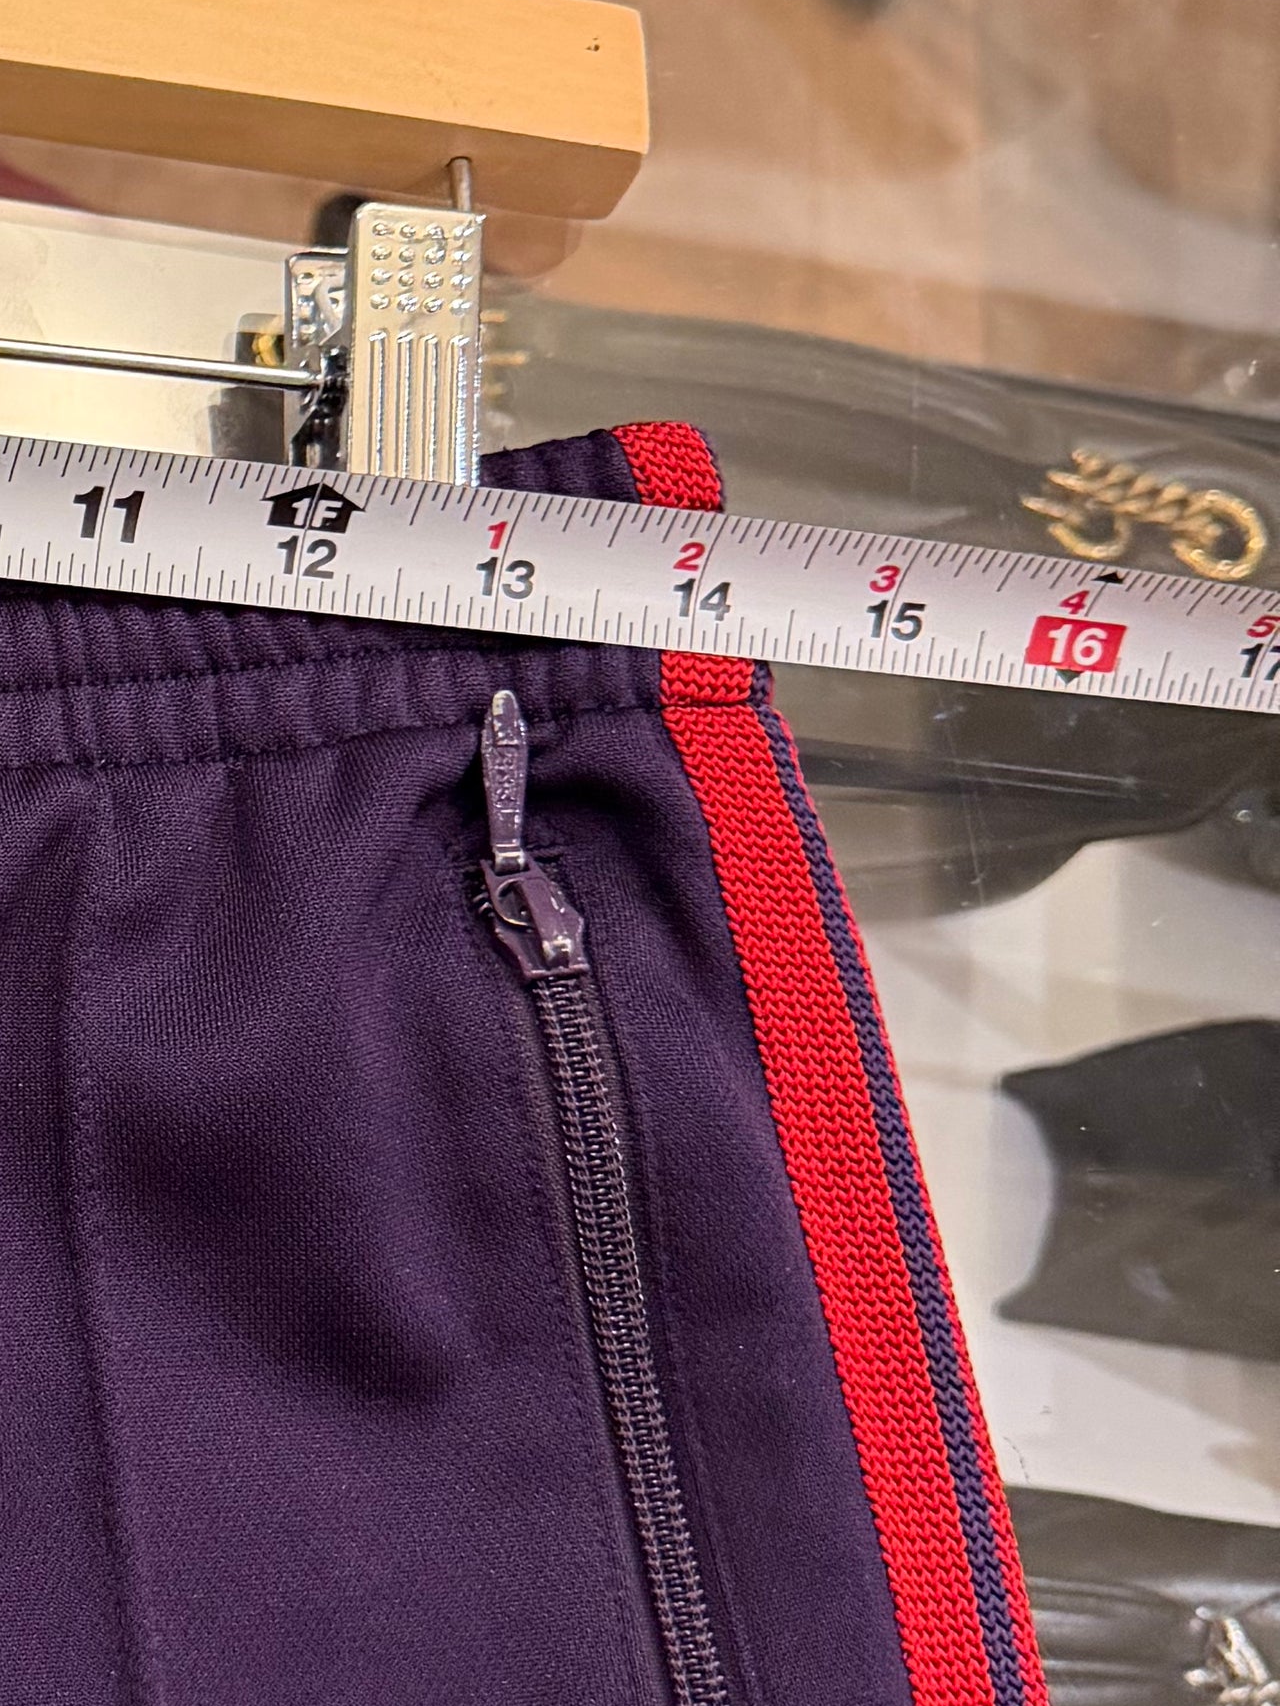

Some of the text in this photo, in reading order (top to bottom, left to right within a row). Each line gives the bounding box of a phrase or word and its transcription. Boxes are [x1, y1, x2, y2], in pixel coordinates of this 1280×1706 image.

[73, 485, 145, 543] 11
[292, 498, 343, 528] 1F
[487, 521, 508, 549] 1
[277, 535, 337, 579] 12
[673, 542, 705, 571] 2
[476, 556, 535, 600] 13
[869, 565, 900, 593] 3
[673, 578, 731, 621] 14
[1058, 590, 1090, 614] 4
[866, 599, 926, 641] 15
[1246, 615, 1280, 638] 5
[1048, 624, 1107, 666] 16
